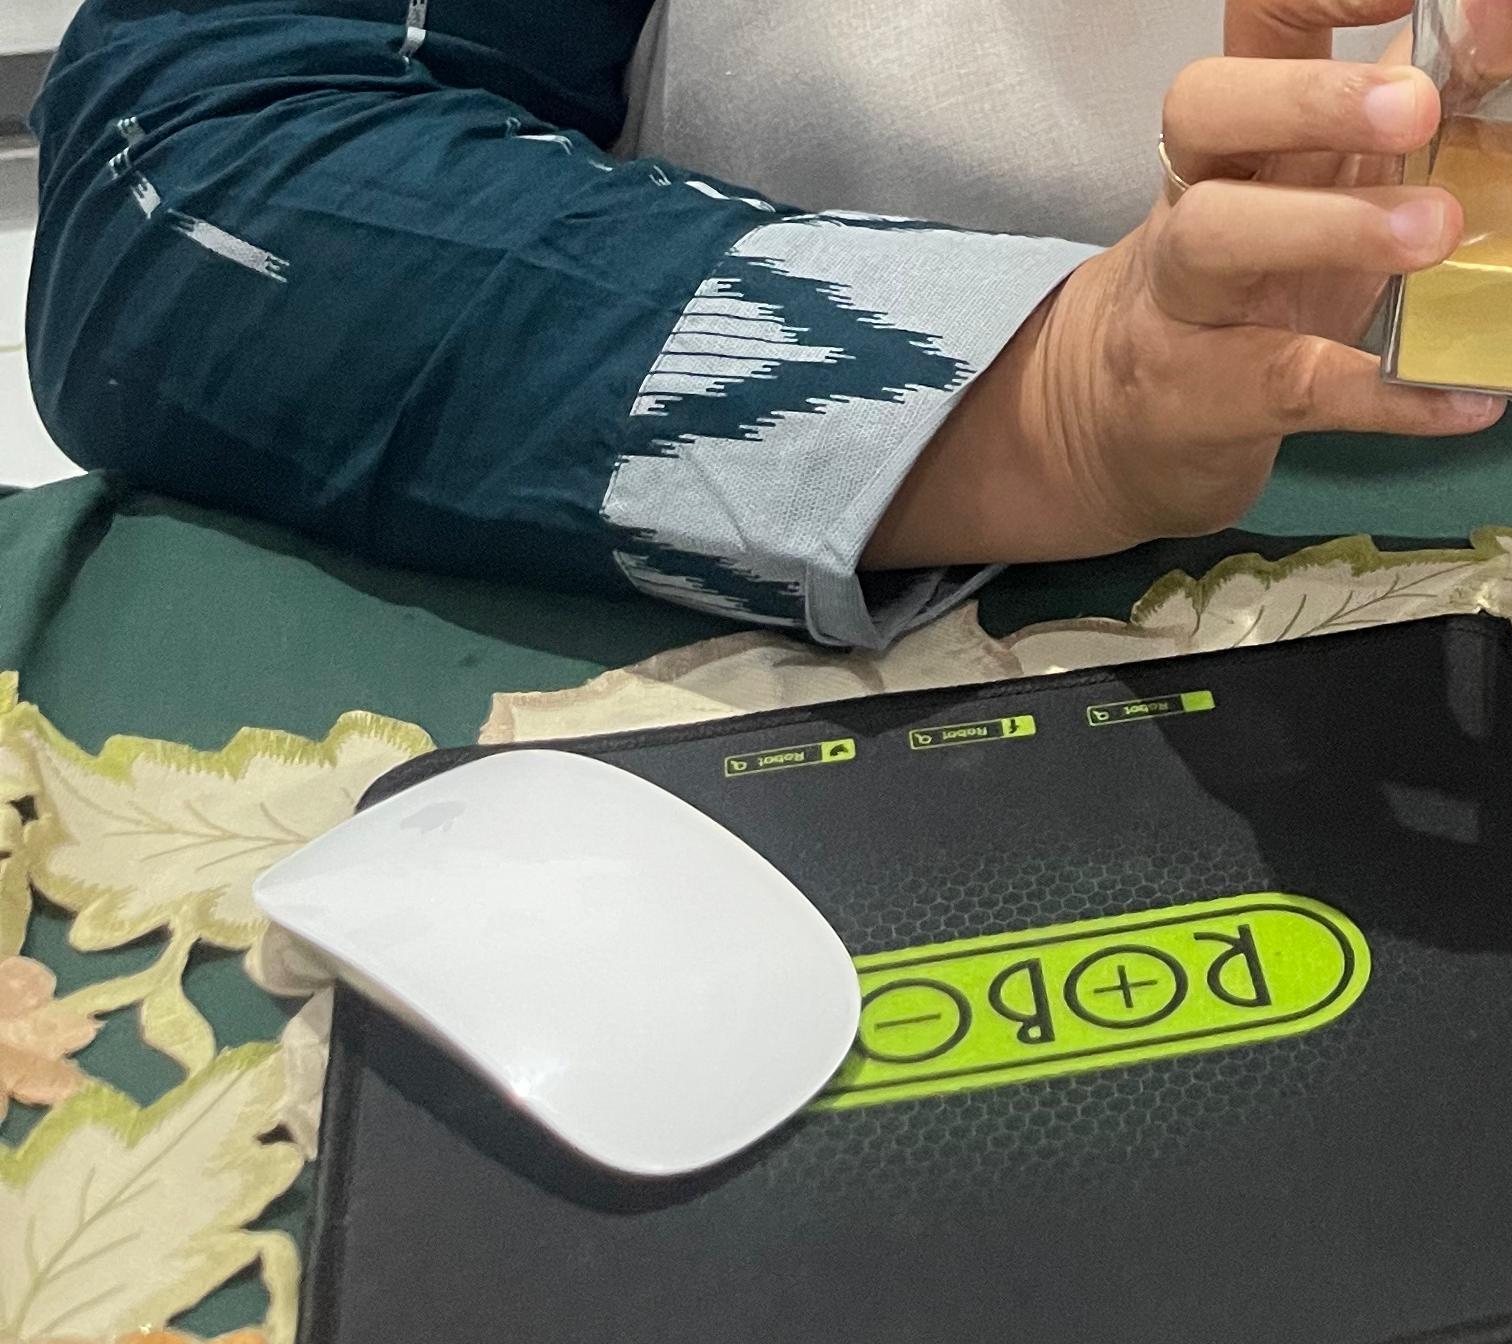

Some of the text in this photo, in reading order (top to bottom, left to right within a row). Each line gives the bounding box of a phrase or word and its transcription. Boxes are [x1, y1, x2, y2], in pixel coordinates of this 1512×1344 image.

[1123, 700, 1169, 716] Robot
[943, 727, 988, 742] Robot
[757, 751, 804, 768] Robot
